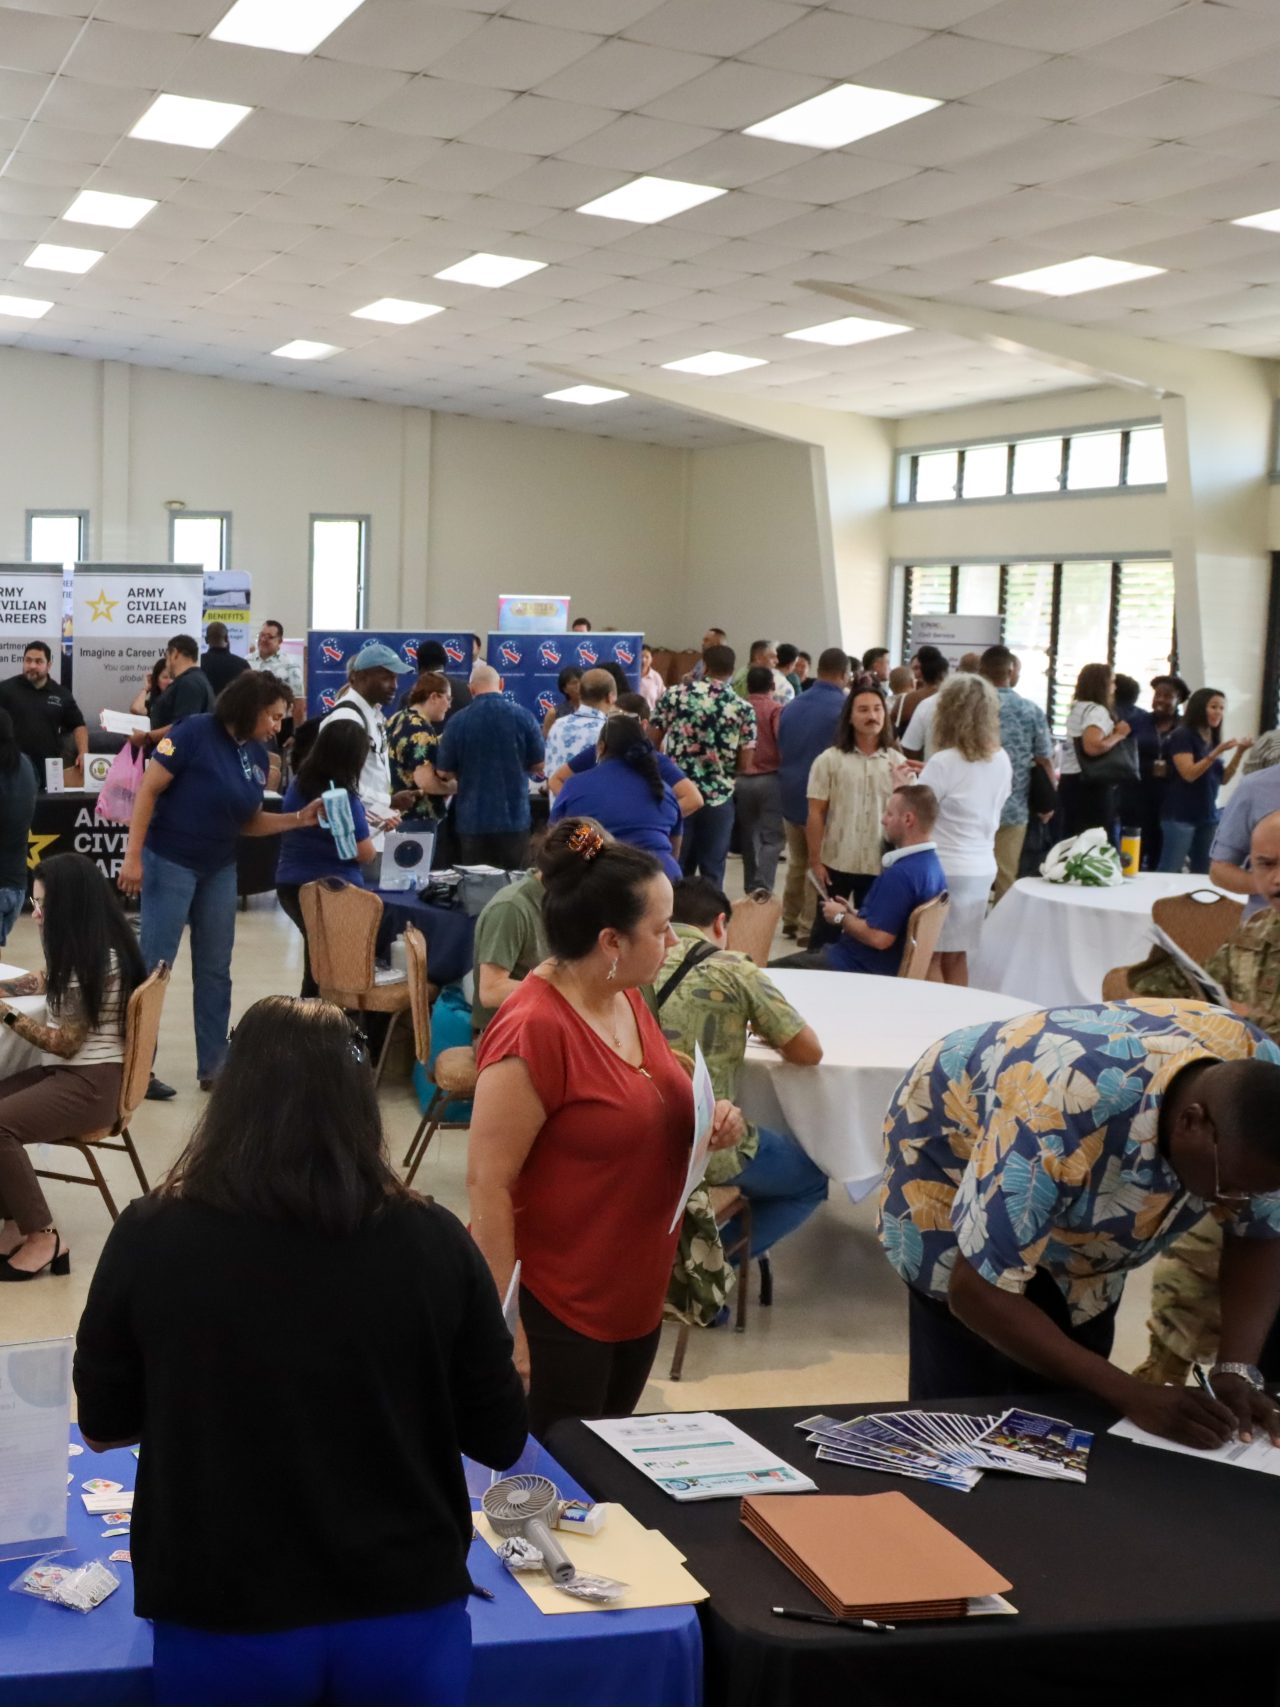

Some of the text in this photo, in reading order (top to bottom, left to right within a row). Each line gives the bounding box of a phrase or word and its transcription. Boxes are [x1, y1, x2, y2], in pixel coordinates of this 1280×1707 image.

[127, 588, 165, 598] ARMY
[127, 601, 187, 611] CIVILIAN
[126, 614, 187, 624] CAREERS
[207, 612, 245, 621] BENEFITS
[80, 647, 116, 659] Imagine
[118, 649, 124, 657] a
[126, 647, 156, 657] Career
[104, 663, 118, 671] You
[119, 674, 144, 684] global
[74, 808, 128, 828] AR
[74, 833, 129, 853] CIVI
